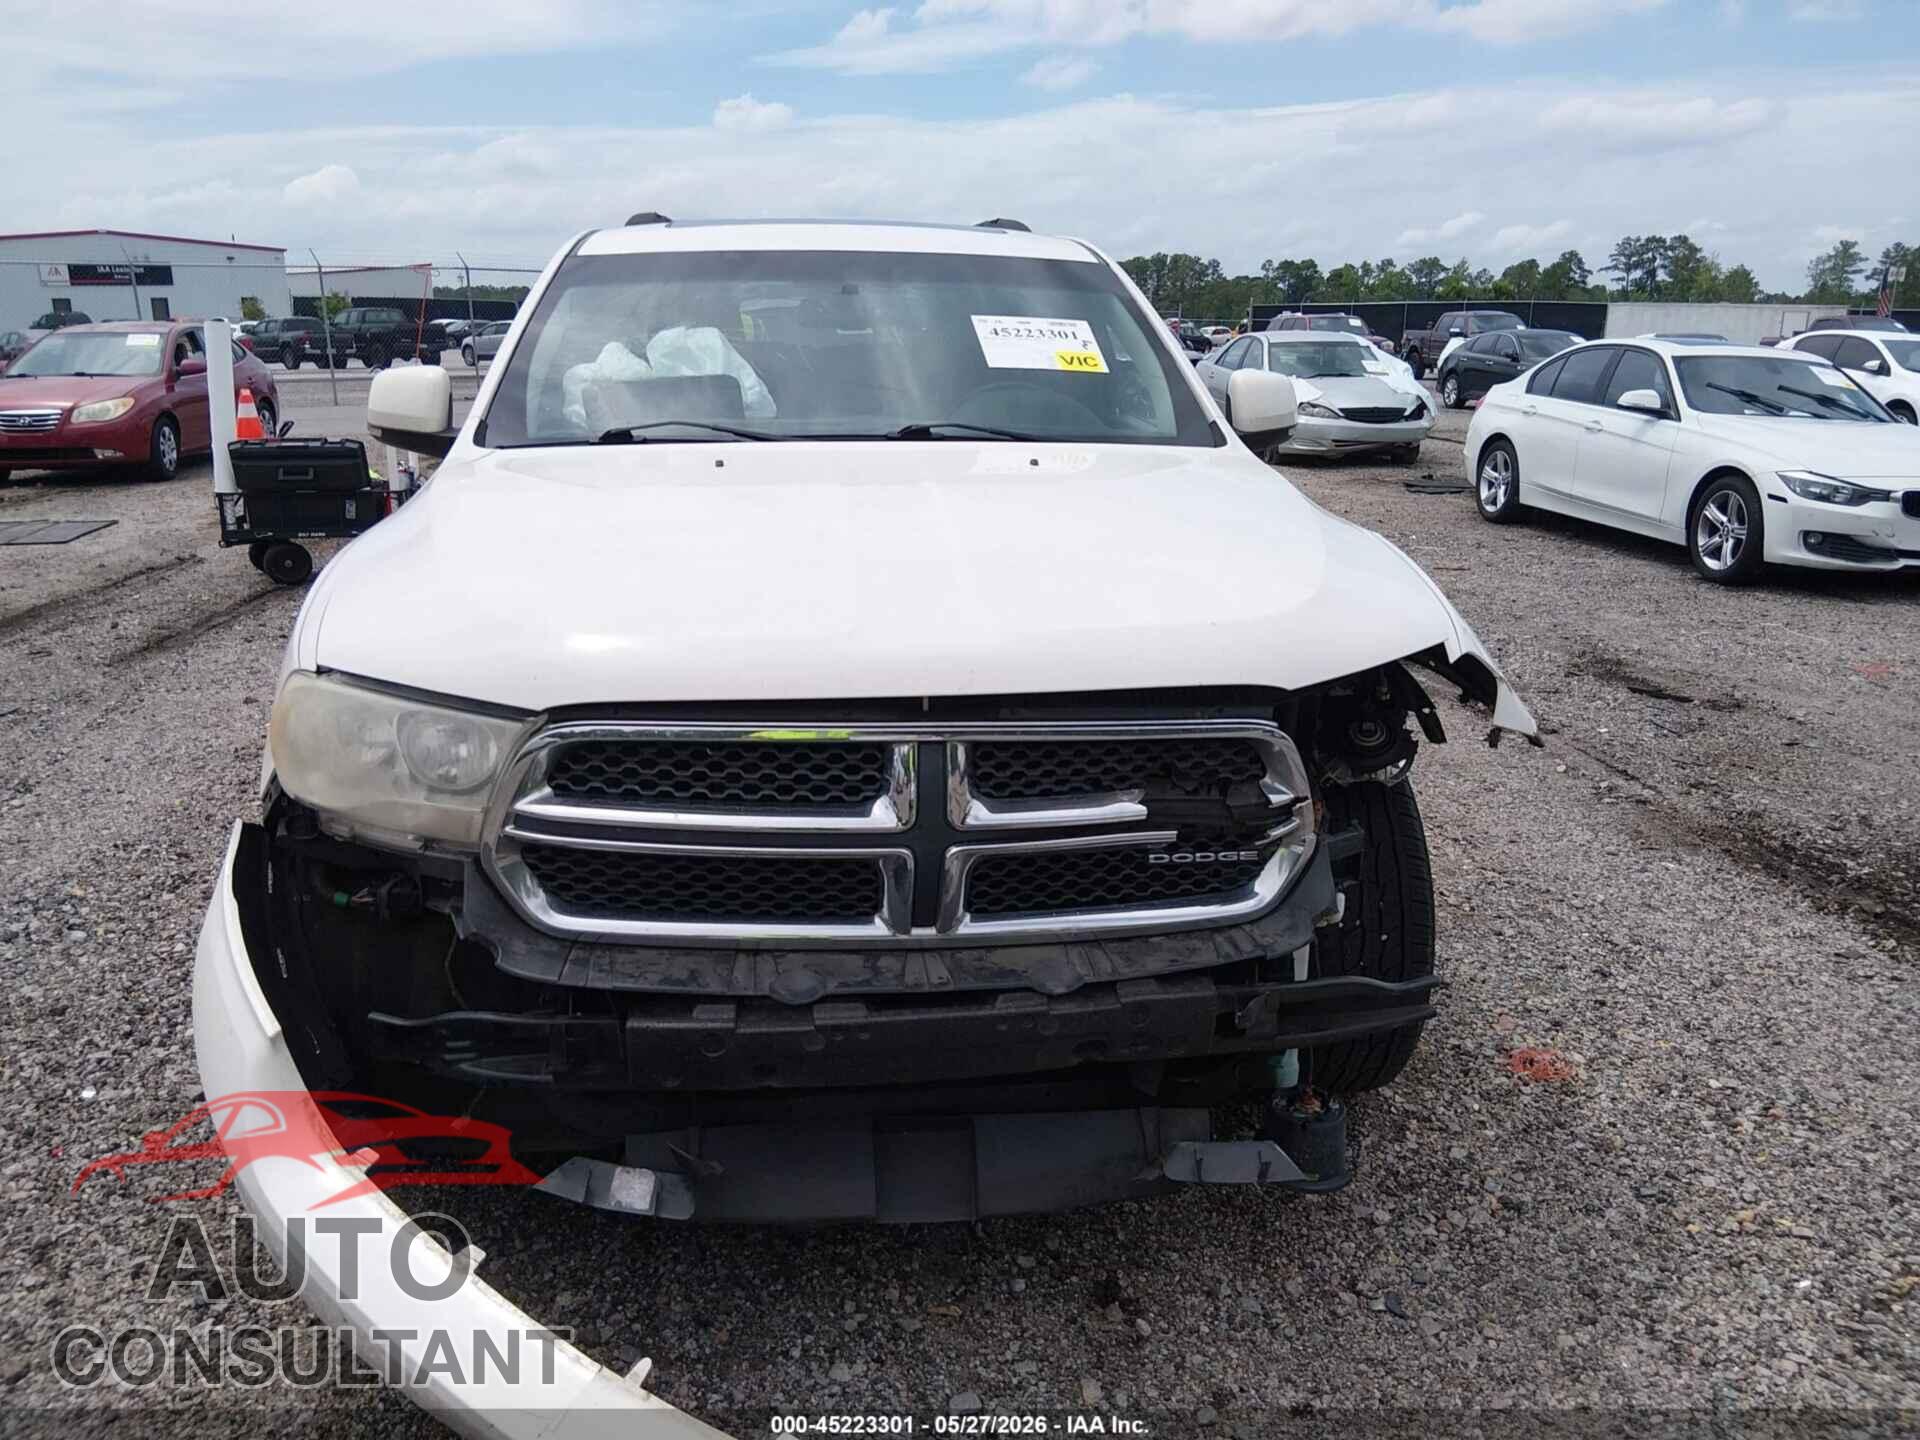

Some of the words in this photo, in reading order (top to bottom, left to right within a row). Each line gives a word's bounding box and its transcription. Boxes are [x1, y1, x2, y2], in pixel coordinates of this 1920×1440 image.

[990, 327, 1078, 340] 45223301
[1060, 355, 1098, 367] VIC
[1148, 851, 1259, 863] DODGE
